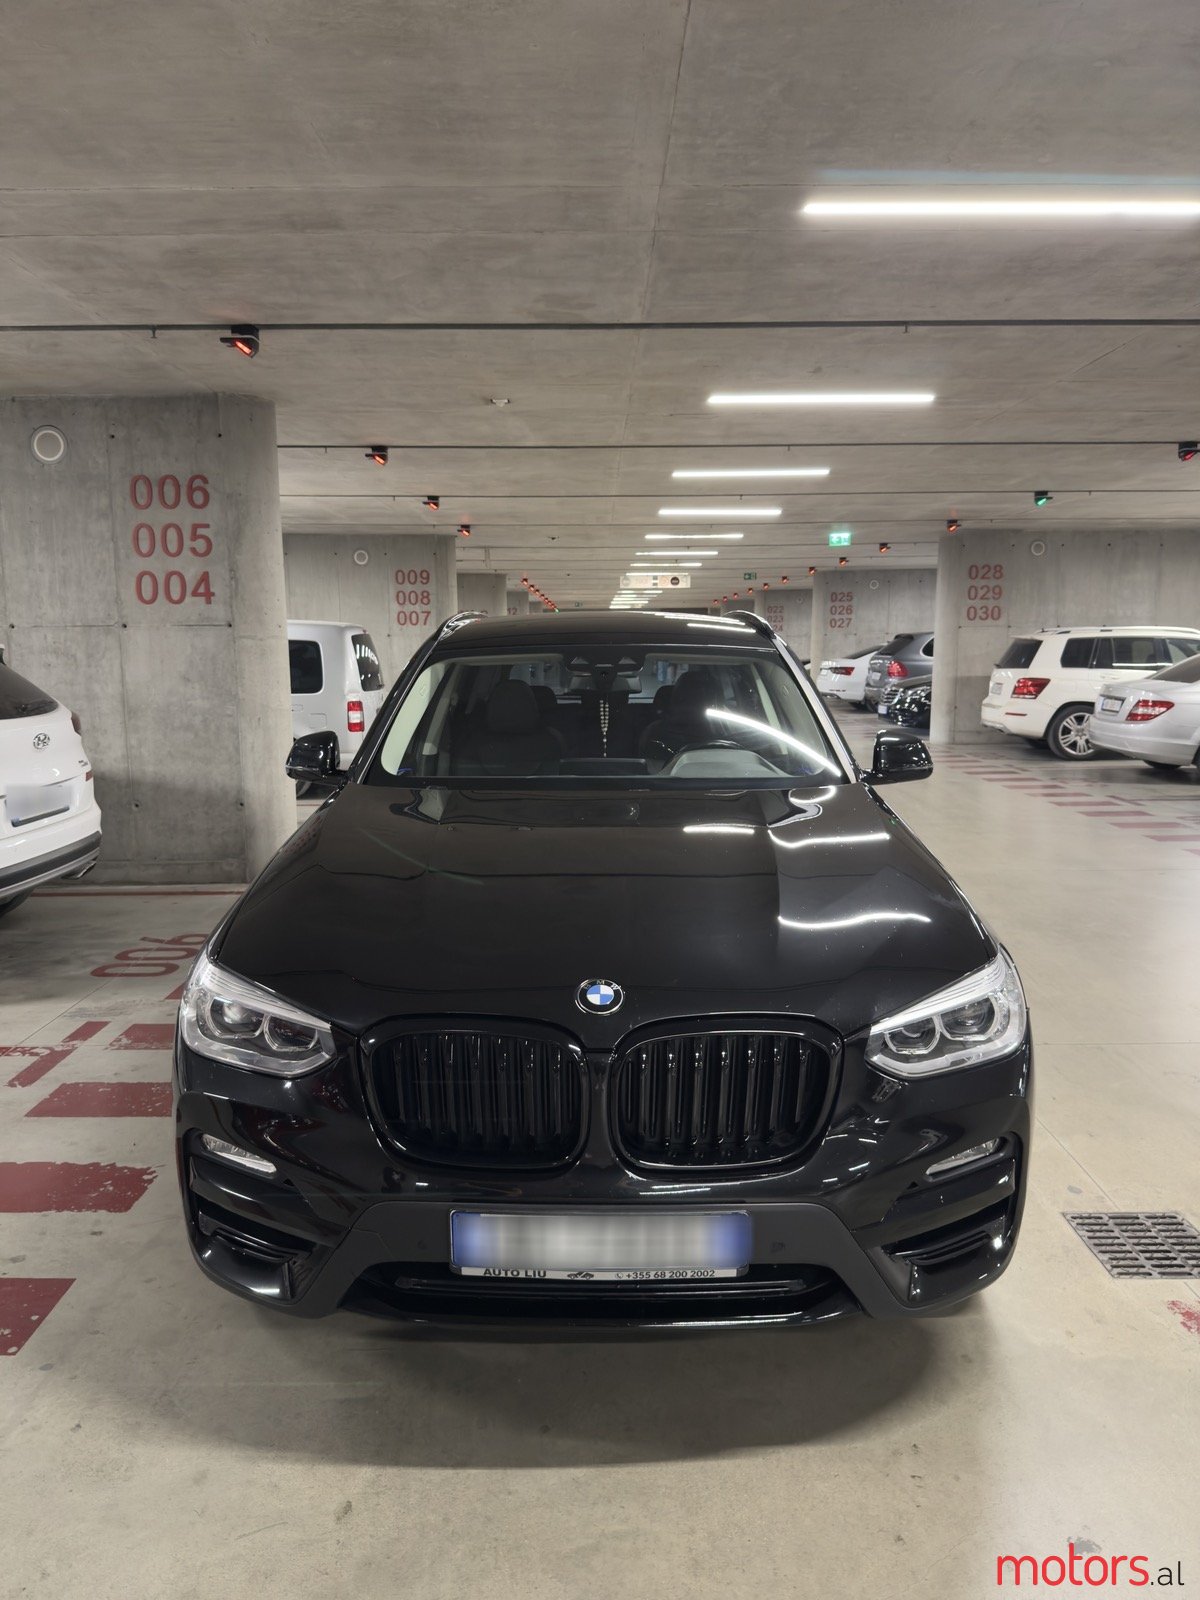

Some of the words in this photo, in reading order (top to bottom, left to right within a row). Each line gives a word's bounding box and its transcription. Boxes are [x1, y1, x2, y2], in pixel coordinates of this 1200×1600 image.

[129, 474, 210, 510] 006
[132, 523, 213, 558] 005
[395, 569, 430, 585] 009
[968, 564, 1004, 580] 028
[135, 570, 215, 605] 004
[967, 585, 1003, 601] 029
[396, 590, 431, 606] 008
[830, 592, 854, 602] 025
[397, 610, 431, 626] 007
[830, 605, 853, 615] 026
[966, 605, 1002, 621] 030
[830, 618, 853, 628] 027
[483, 1268, 520, 1277] AUTO
[525, 1269, 547, 1278] LIU
[626, 1271, 651, 1279] +355
[653, 1271, 667, 1279] 68
[669, 1270, 688, 1278] 200
[690, 1269, 716, 1278] 2002
